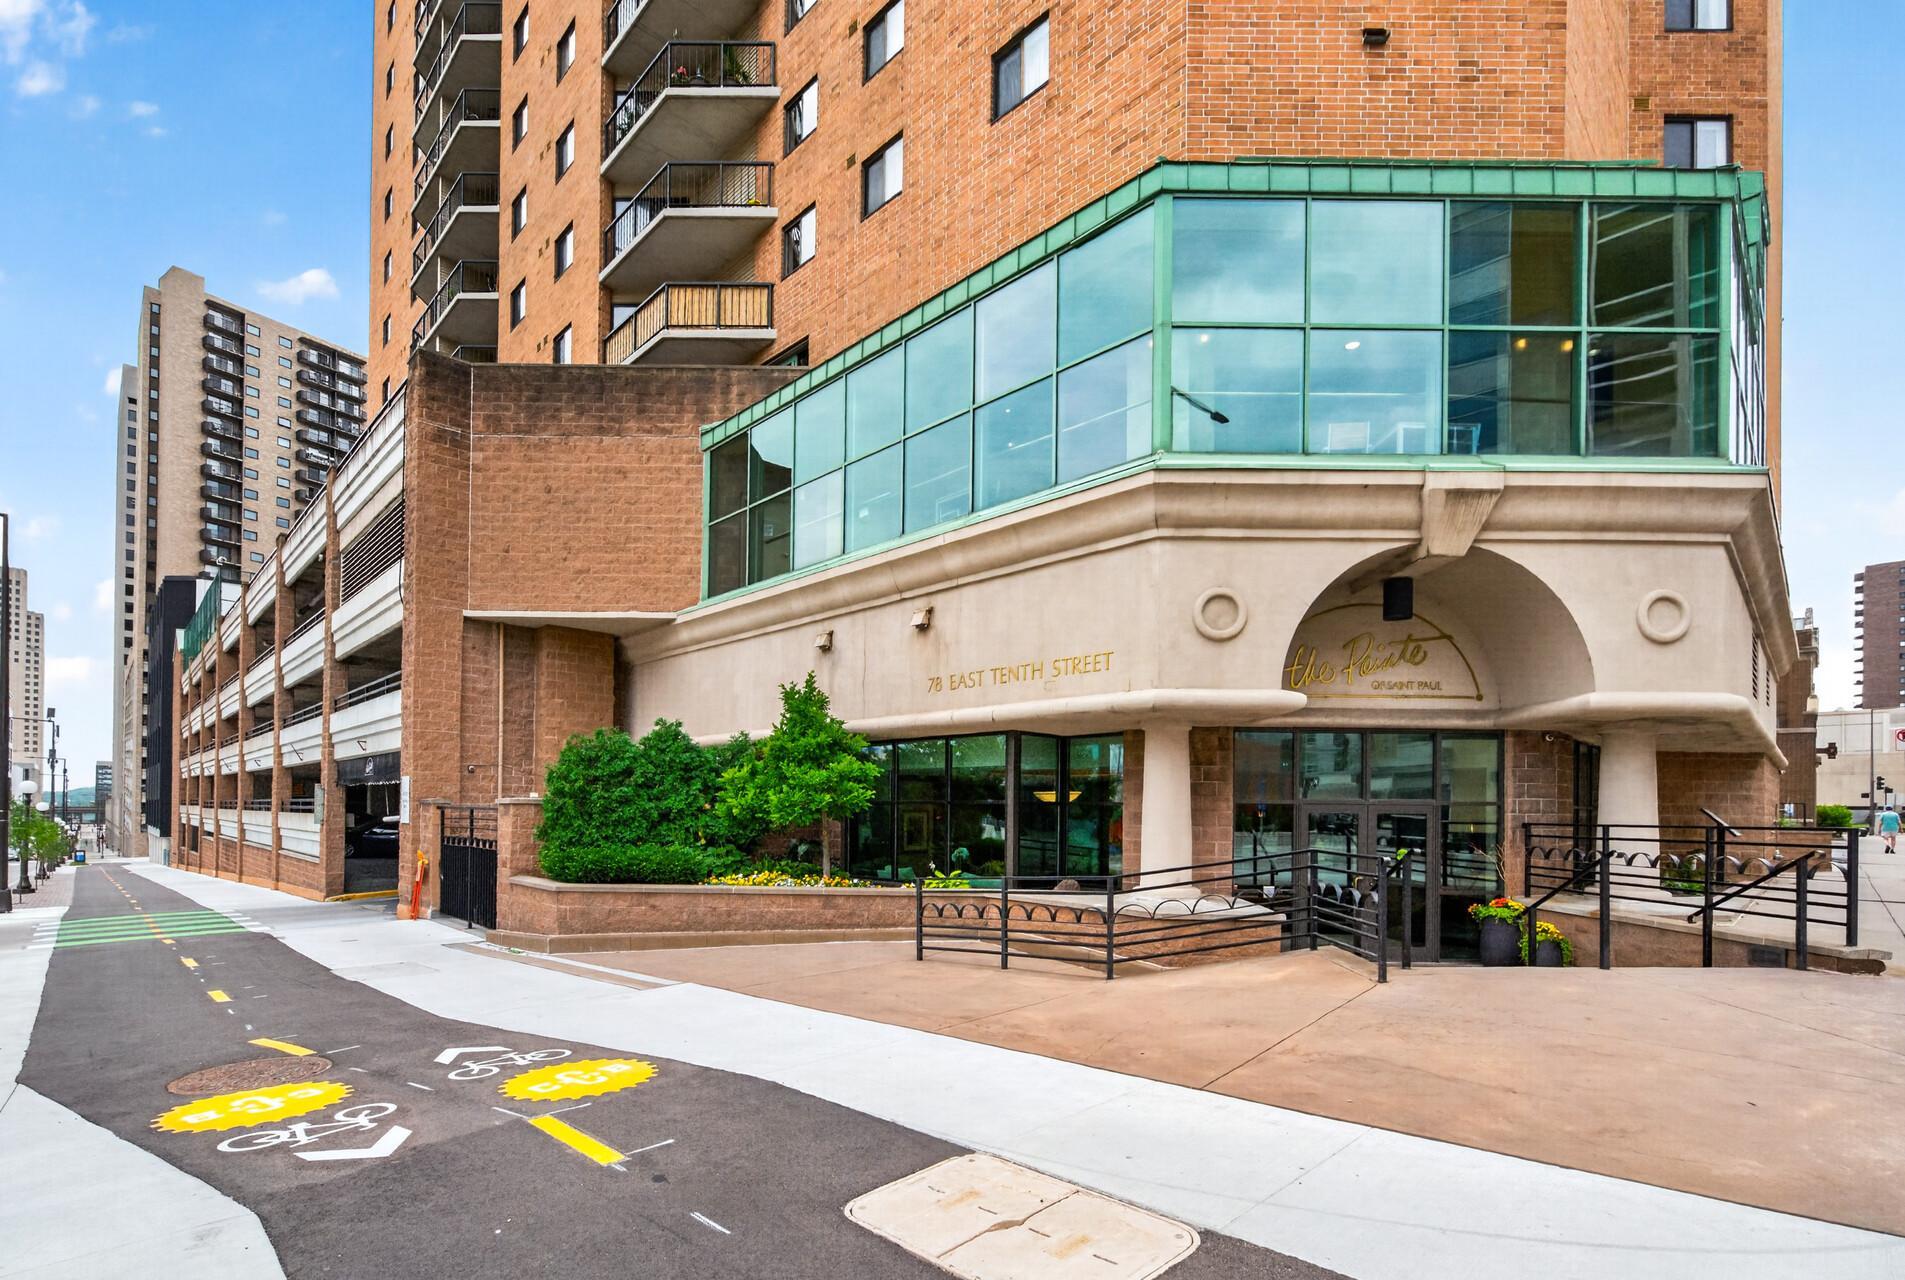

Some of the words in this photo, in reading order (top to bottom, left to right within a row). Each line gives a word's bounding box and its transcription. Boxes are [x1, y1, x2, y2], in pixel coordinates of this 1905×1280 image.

[927, 676, 943, 694] 78
[949, 670, 985, 691] EAST
[989, 660, 1044, 685] TENTH
[1051, 651, 1115, 678] STREET
[1284, 643, 1337, 689] the
[1370, 680, 1384, 691] OF
[1383, 680, 1415, 691] SAINT
[1417, 680, 1443, 691] PAUL
